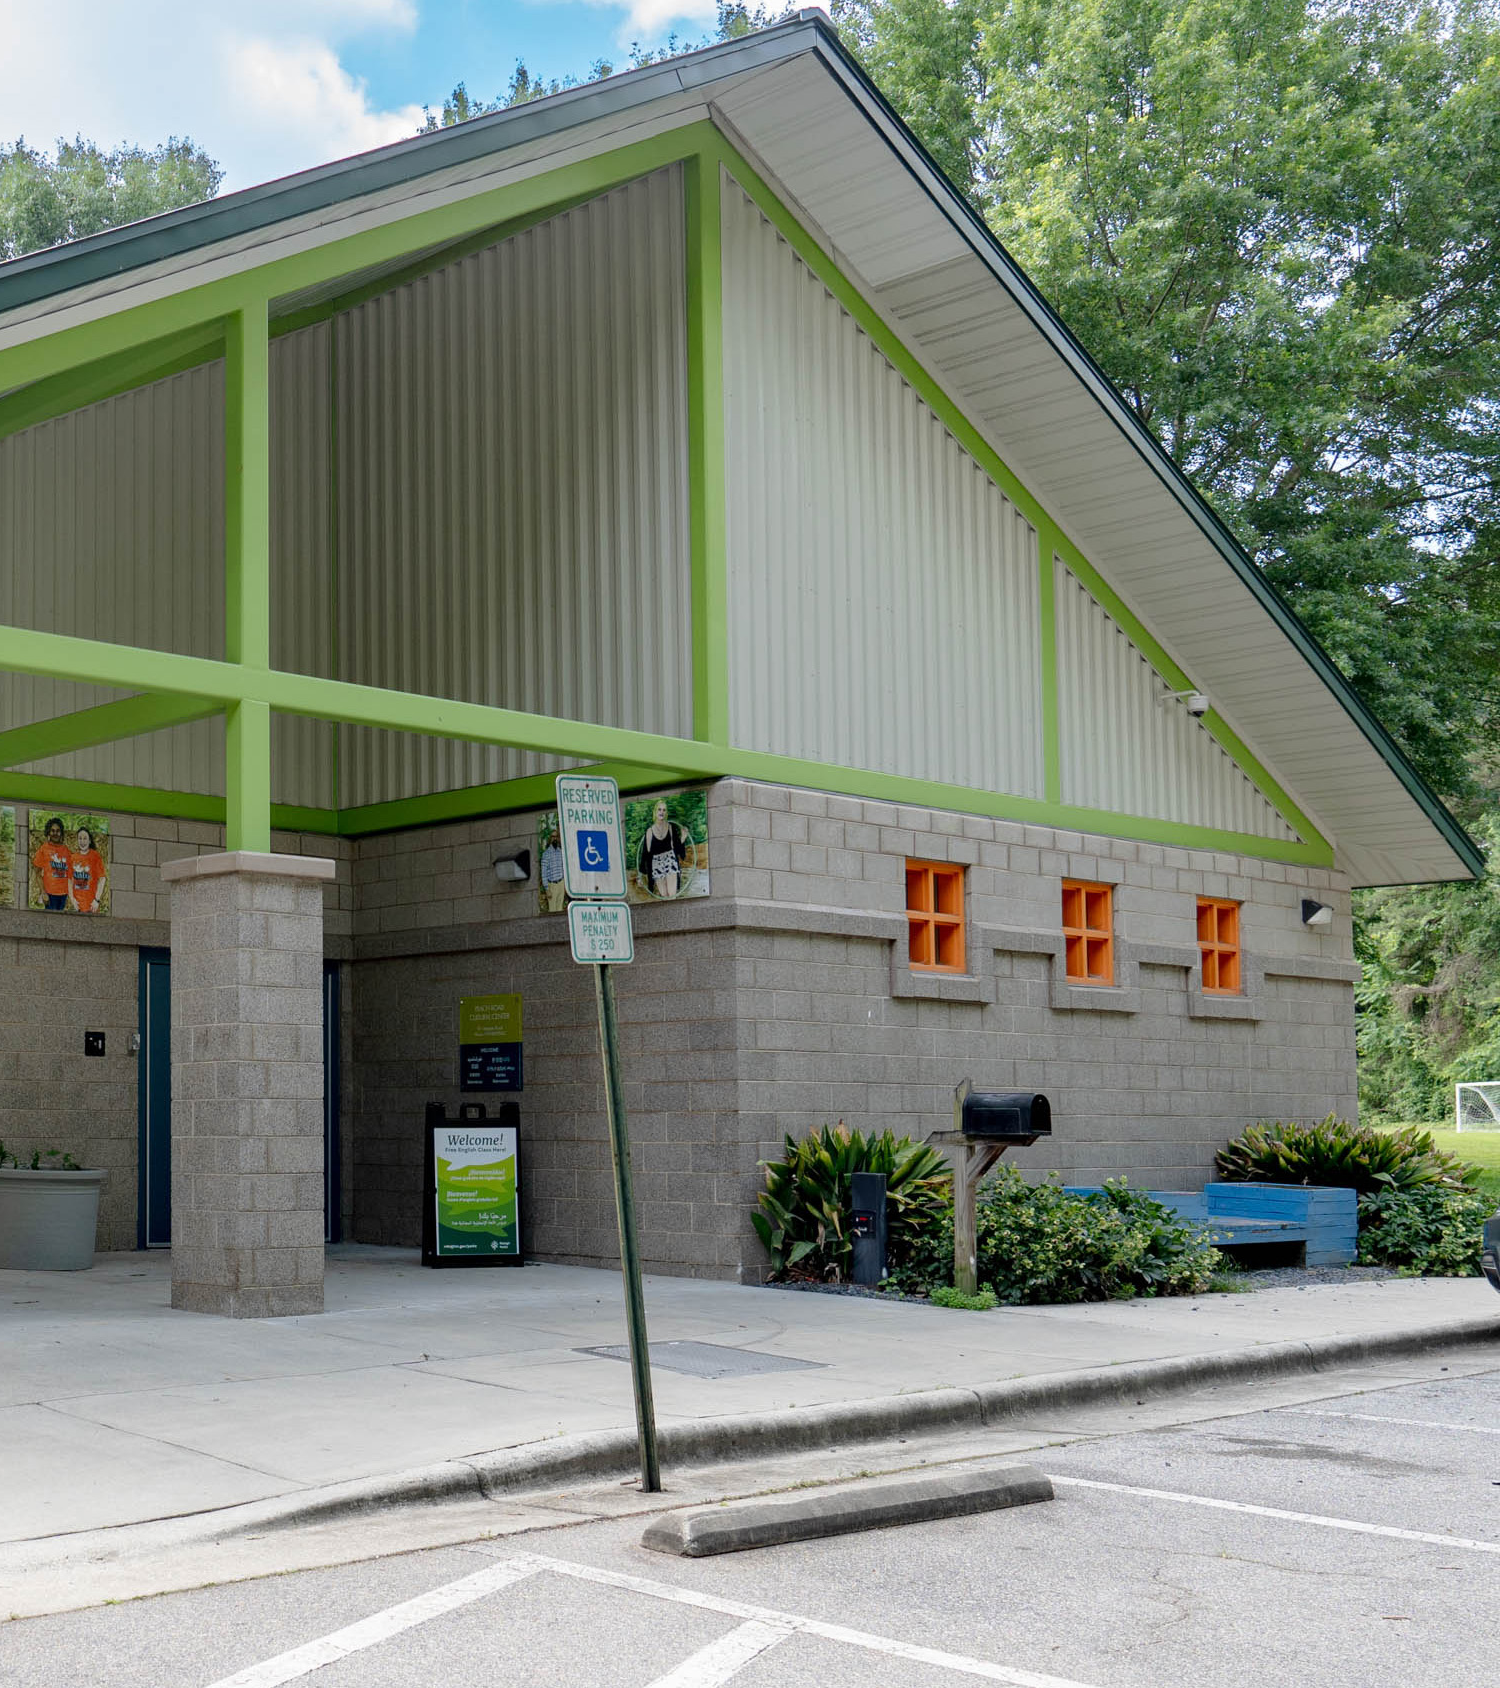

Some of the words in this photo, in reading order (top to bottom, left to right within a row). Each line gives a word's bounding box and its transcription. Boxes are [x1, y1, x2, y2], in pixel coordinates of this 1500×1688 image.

[562, 788, 614, 804] RESERVED
[567, 808, 613, 825] PARKING
[581, 911, 618, 923] MAXIMUM
[582, 925, 618, 937] PENALTY
[598, 939, 615, 950] 250
[447, 1133, 504, 1146] Welcome!
